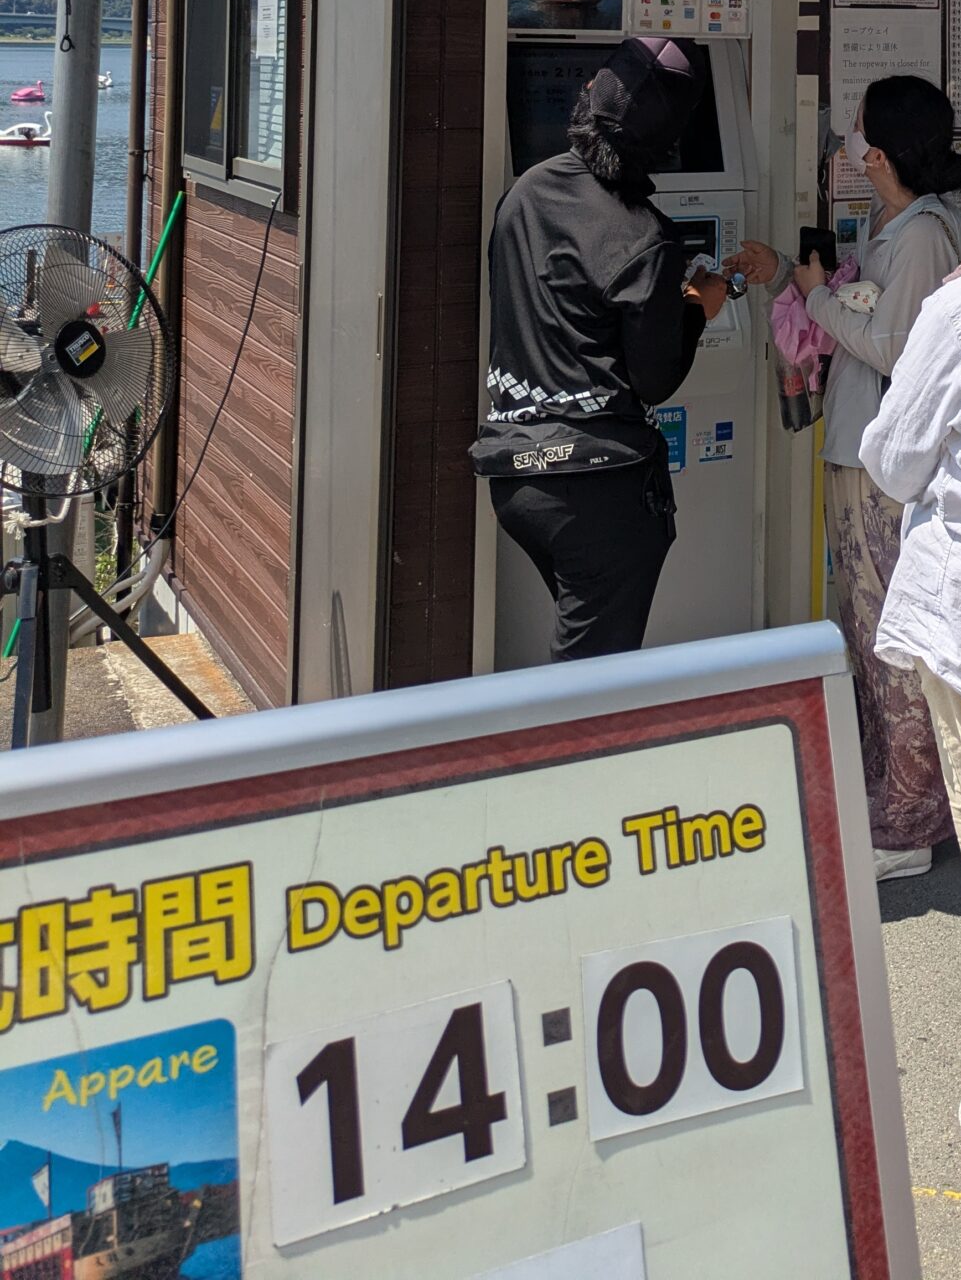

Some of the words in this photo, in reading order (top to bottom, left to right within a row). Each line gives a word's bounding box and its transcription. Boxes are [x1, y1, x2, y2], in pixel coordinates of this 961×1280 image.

[843, 26, 889, 35] ロープウェイ
[843, 60, 857, 68] The
[859, 61, 887, 69] ropeway
[897, 60, 917, 68] closed
[919, 59, 930, 67] for
[513, 443, 575, 471] SEAWOLF
[286, 837, 611, 953] Departure
[622, 803, 766, 875] Time
[42, 1044, 219, 1112] Appare
[297, 942, 784, 1204] 14:00
